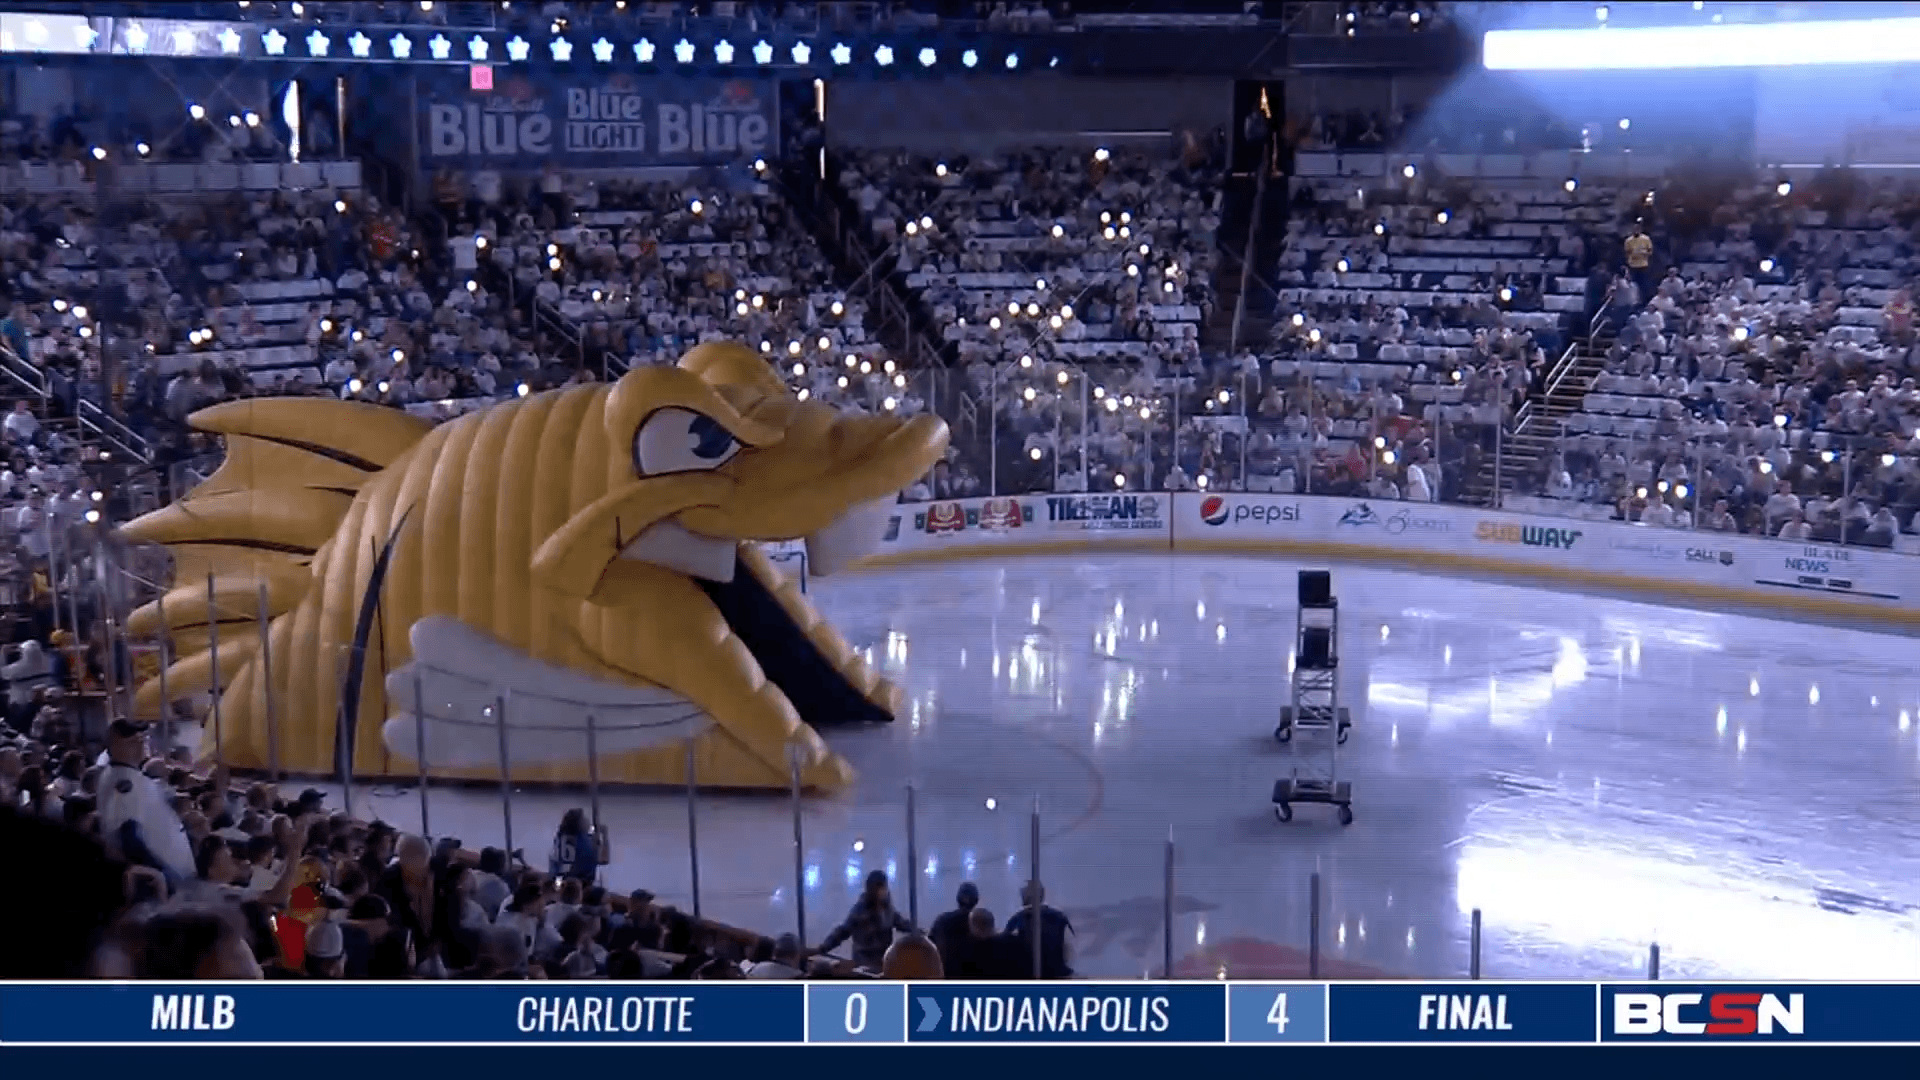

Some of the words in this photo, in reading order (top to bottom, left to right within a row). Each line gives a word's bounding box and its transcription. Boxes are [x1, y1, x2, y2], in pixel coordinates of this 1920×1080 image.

[568, 88, 642, 120] Blue
[430, 104, 552, 155] Blue
[568, 125, 644, 149] LIGHT
[658, 104, 768, 154] Blue
[1235, 503, 1300, 524] pepsi
[1474, 521, 1582, 550] SUBWAY
[1785, 557, 1830, 574] NEWS
